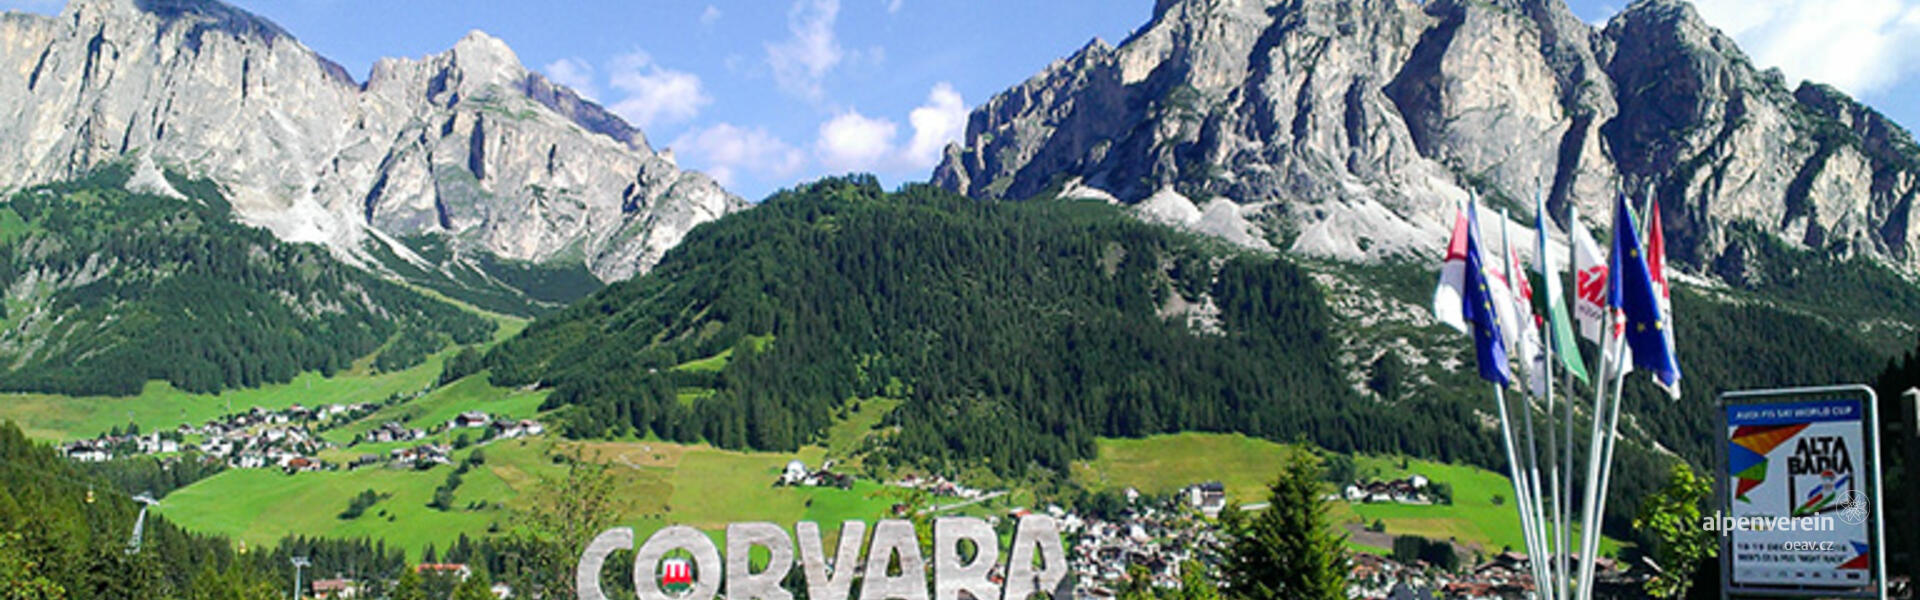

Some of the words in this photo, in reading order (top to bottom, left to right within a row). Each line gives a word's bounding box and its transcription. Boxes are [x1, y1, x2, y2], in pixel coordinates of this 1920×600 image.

[1795, 406, 1831, 416] WORLD
[1832, 405, 1853, 415] CUP
[1796, 436, 1849, 457] ALTA
[1788, 456, 1853, 475] BADIA
[577, 514, 1068, 600] CORVARA
